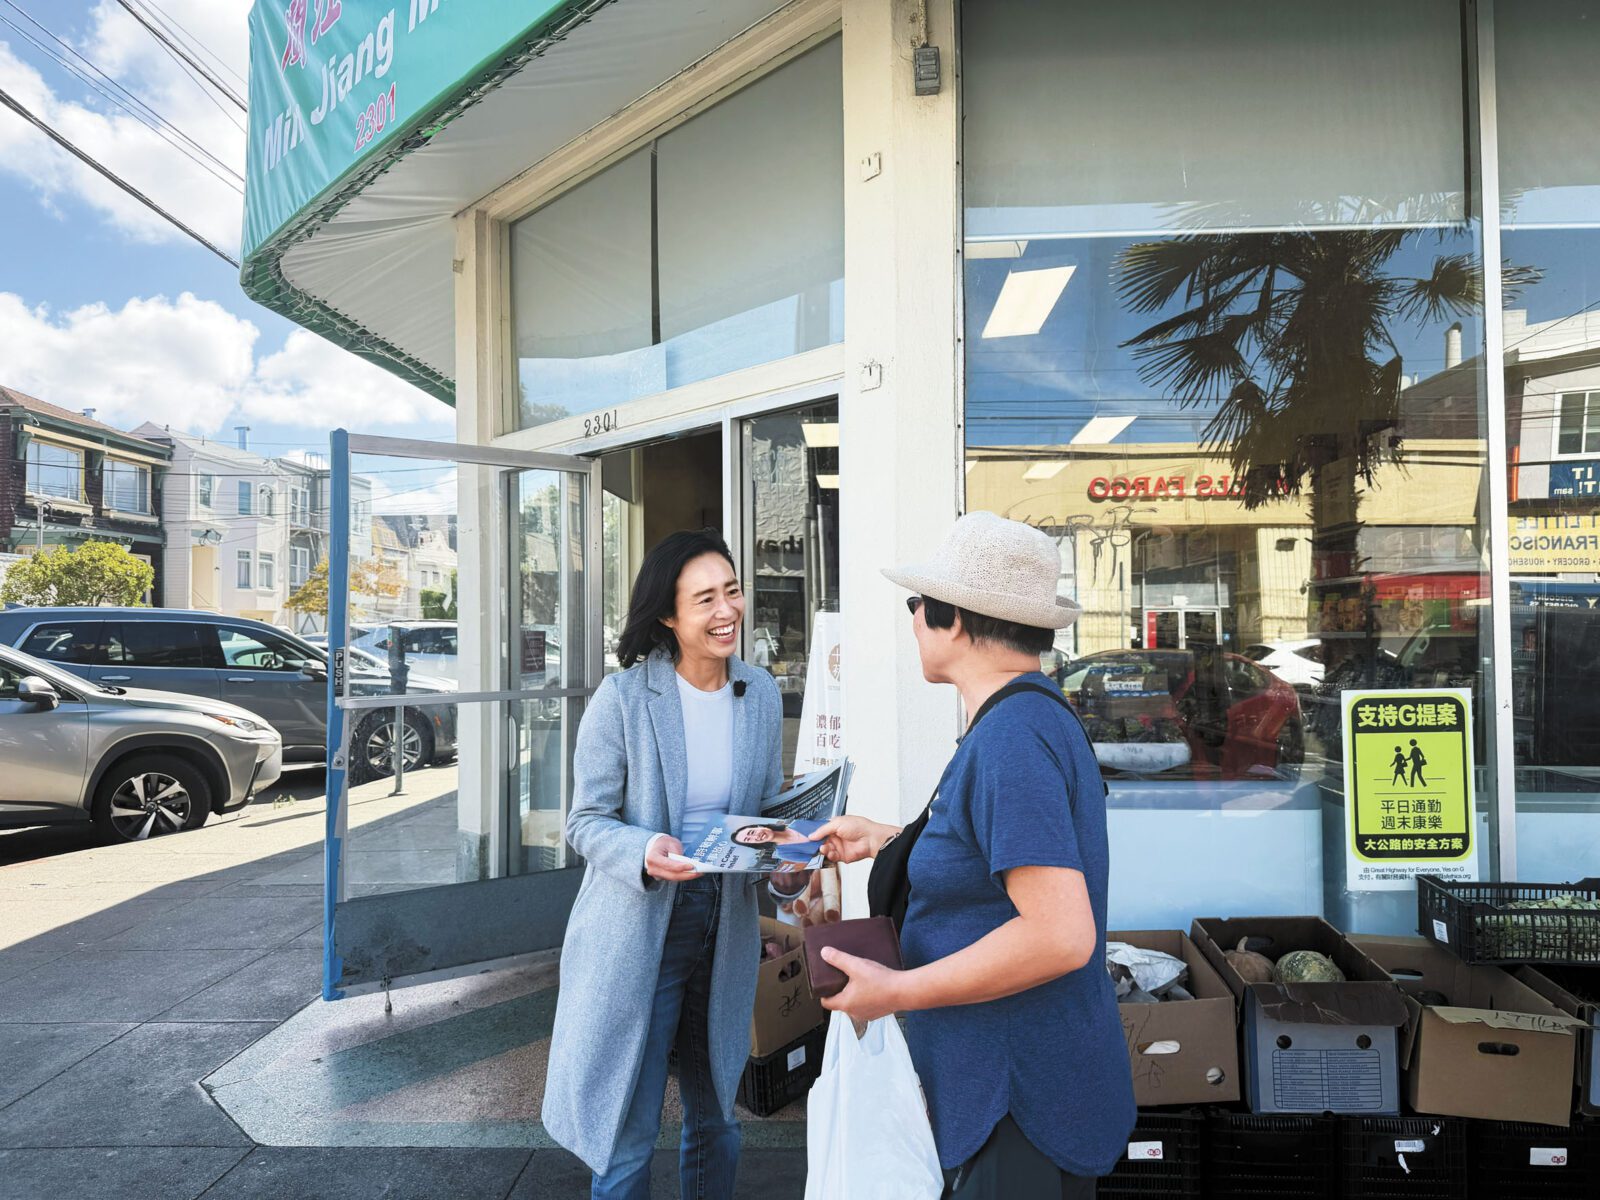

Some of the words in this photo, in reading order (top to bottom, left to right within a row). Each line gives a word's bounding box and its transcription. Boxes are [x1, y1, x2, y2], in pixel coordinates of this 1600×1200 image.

[310, 8, 395, 125] Jiang
[354, 81, 396, 153] 2301
[584, 409, 617, 438] 2301
[335, 652, 343, 686] PUSH
[1357, 703, 1458, 728] 支持G提案
[1380, 799, 1442, 815] 平日通勤
[1381, 815, 1443, 830] 週末康樂
[1364, 837, 1464, 851] 大公路的安全方案
